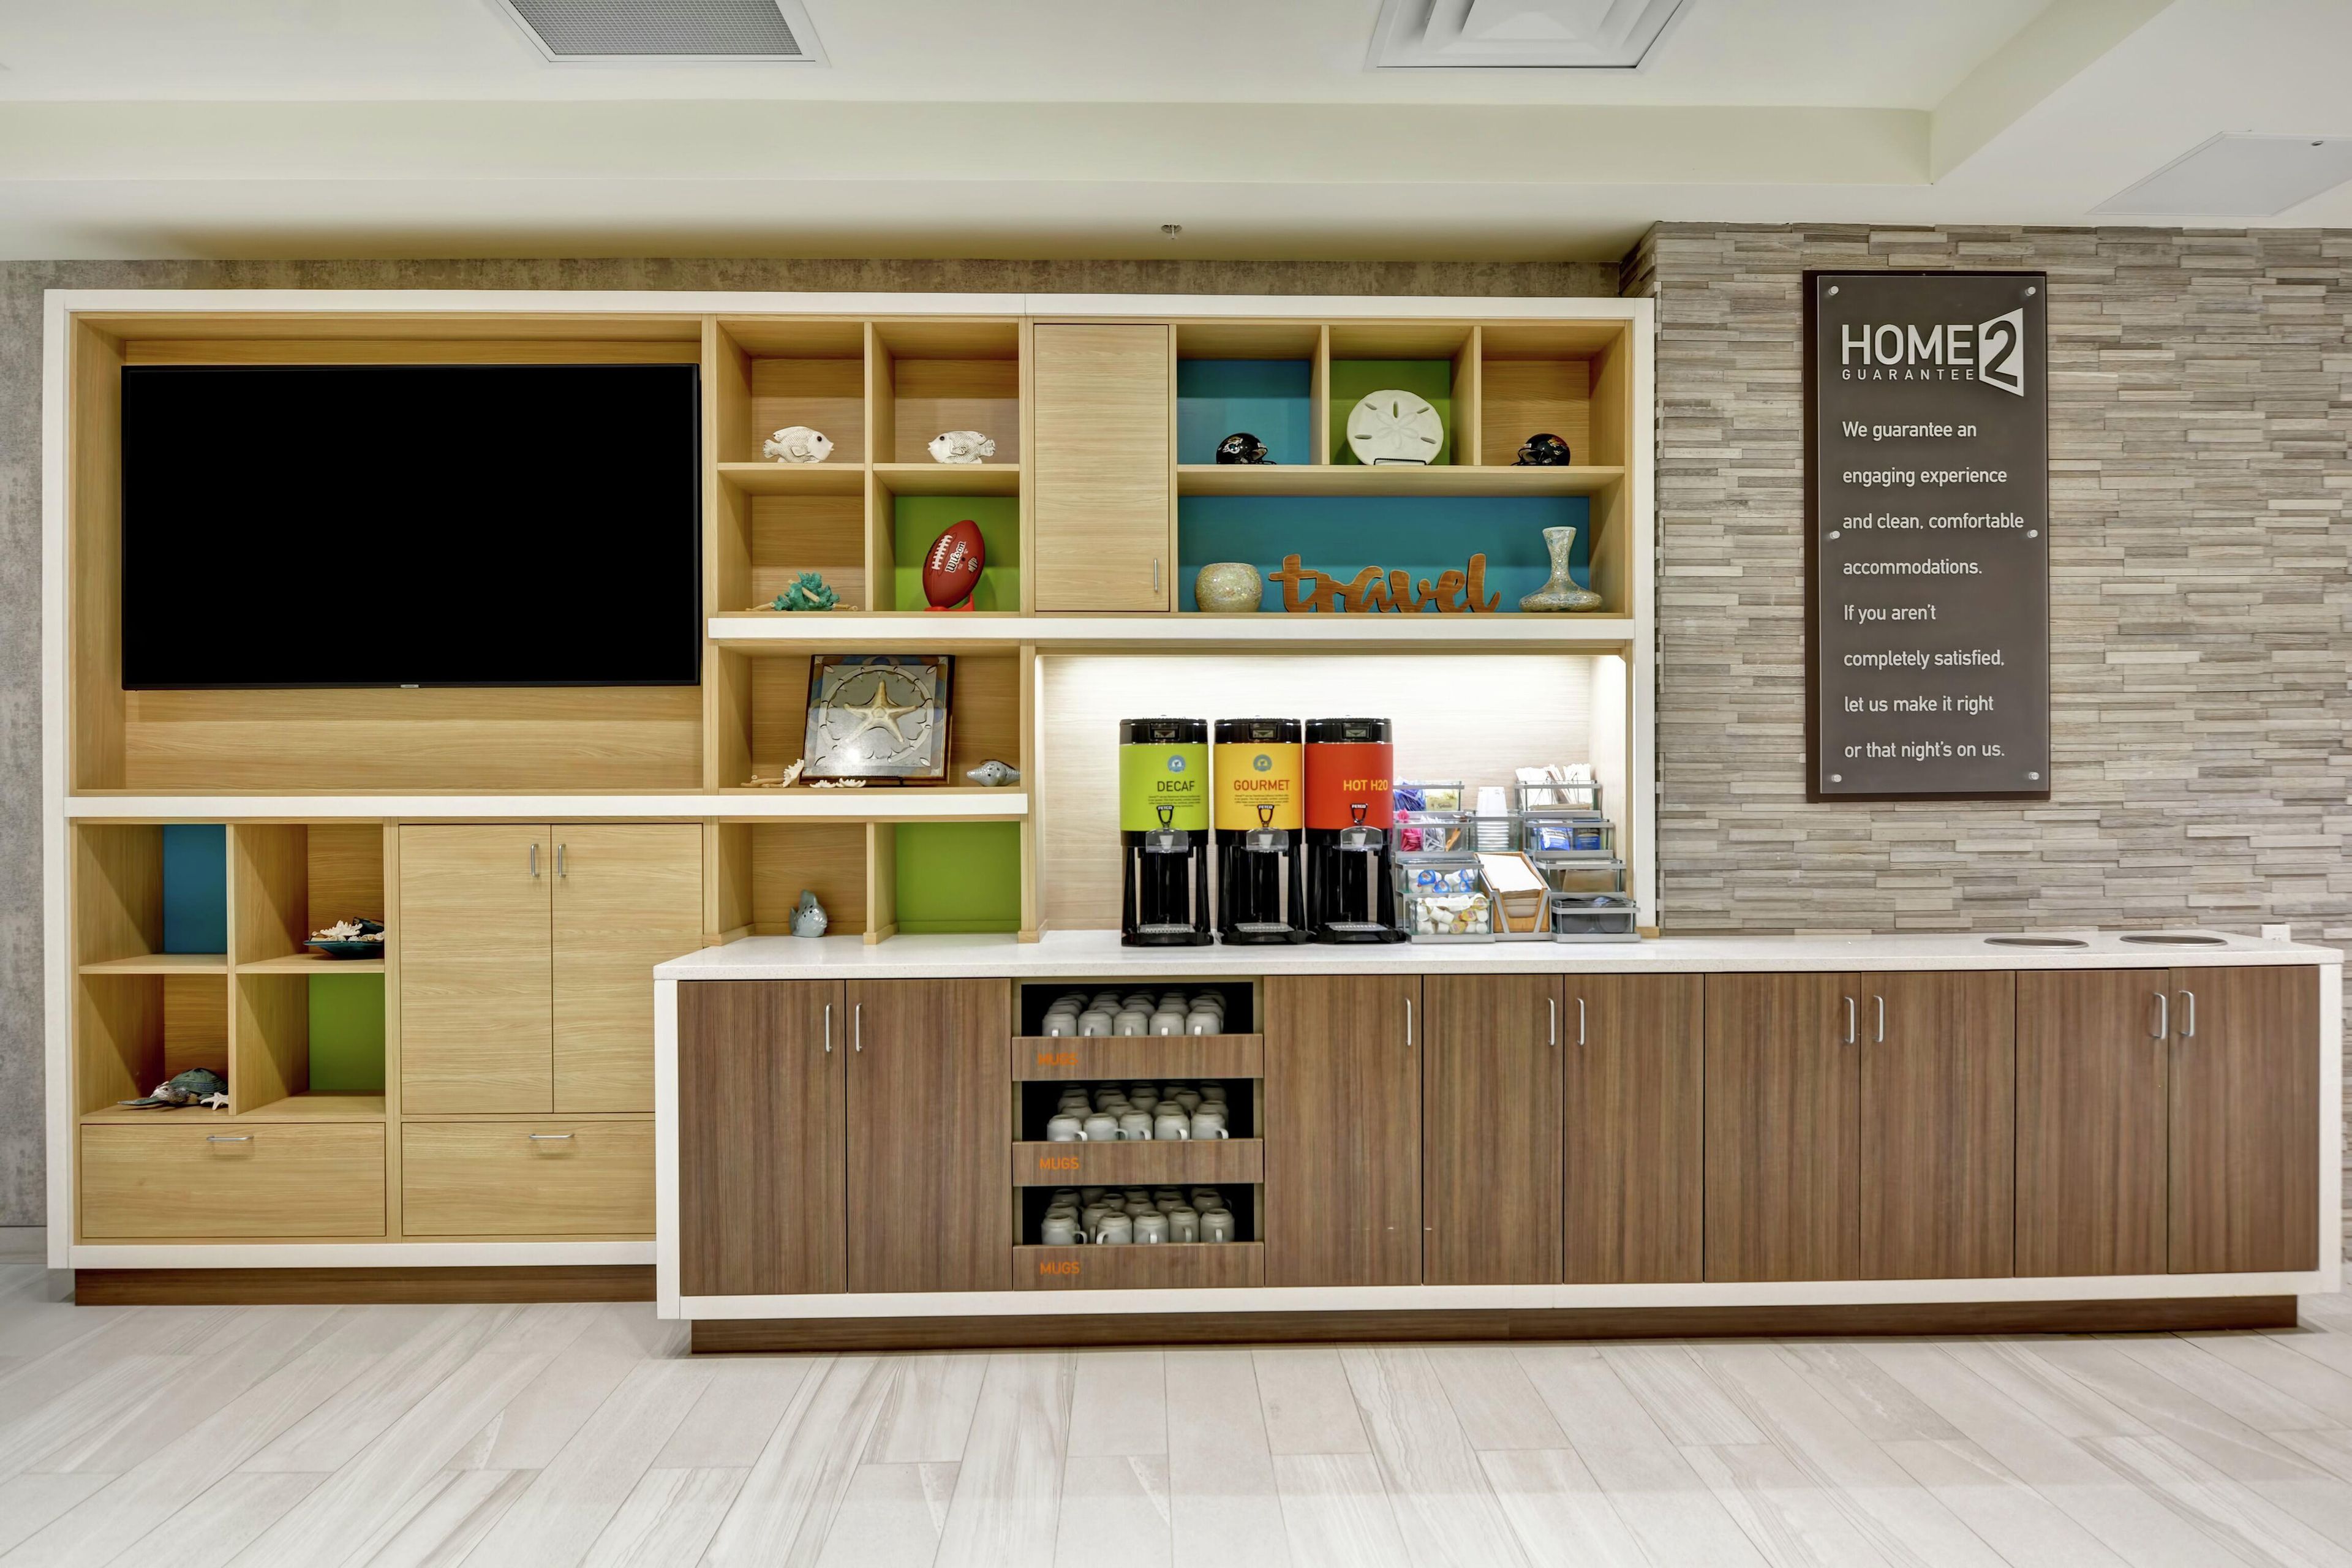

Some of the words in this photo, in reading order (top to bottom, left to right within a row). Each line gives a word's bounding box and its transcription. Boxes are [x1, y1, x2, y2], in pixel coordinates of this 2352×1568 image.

[1842, 324, 1973, 365] HOME
[1842, 369, 1973, 380] GUARANTEE
[1842, 421, 1868, 437] We
[1872, 422, 1953, 442] guarantee
[1957, 425, 1977, 437] an
[1843, 467, 1915, 488] engaging
[1920, 467, 2007, 487] experience
[1842, 513, 1872, 529] and
[1929, 512, 2024, 529] comfortable
[944, 541, 966, 573] Wilson
[1843, 558, 1982, 575] accommodations.
[1268, 553, 1501, 613] travel
[1844, 604, 1855, 620] If
[1858, 608, 1887, 625] you
[1844, 650, 1930, 670] completely
[1845, 696, 1864, 712] let
[1869, 699, 1888, 712] us
[1893, 695, 1937, 712] make
[1943, 695, 1952, 711] it
[1957, 695, 1994, 715] right
[1845, 745, 1863, 758] or
[1866, 741, 1896, 758] that
[1957, 745, 1976, 757] on
[1982, 744, 2005, 756] us.
[1157, 780, 1195, 792] DECAF
[1234, 779, 1290, 791] GOURMET
[1343, 779, 1368, 791] HOT
[1038, 1052, 1079, 1066] MUGS
[1039, 1157, 1079, 1170] MUGS
[1039, 1262, 1080, 1275] MUGS
